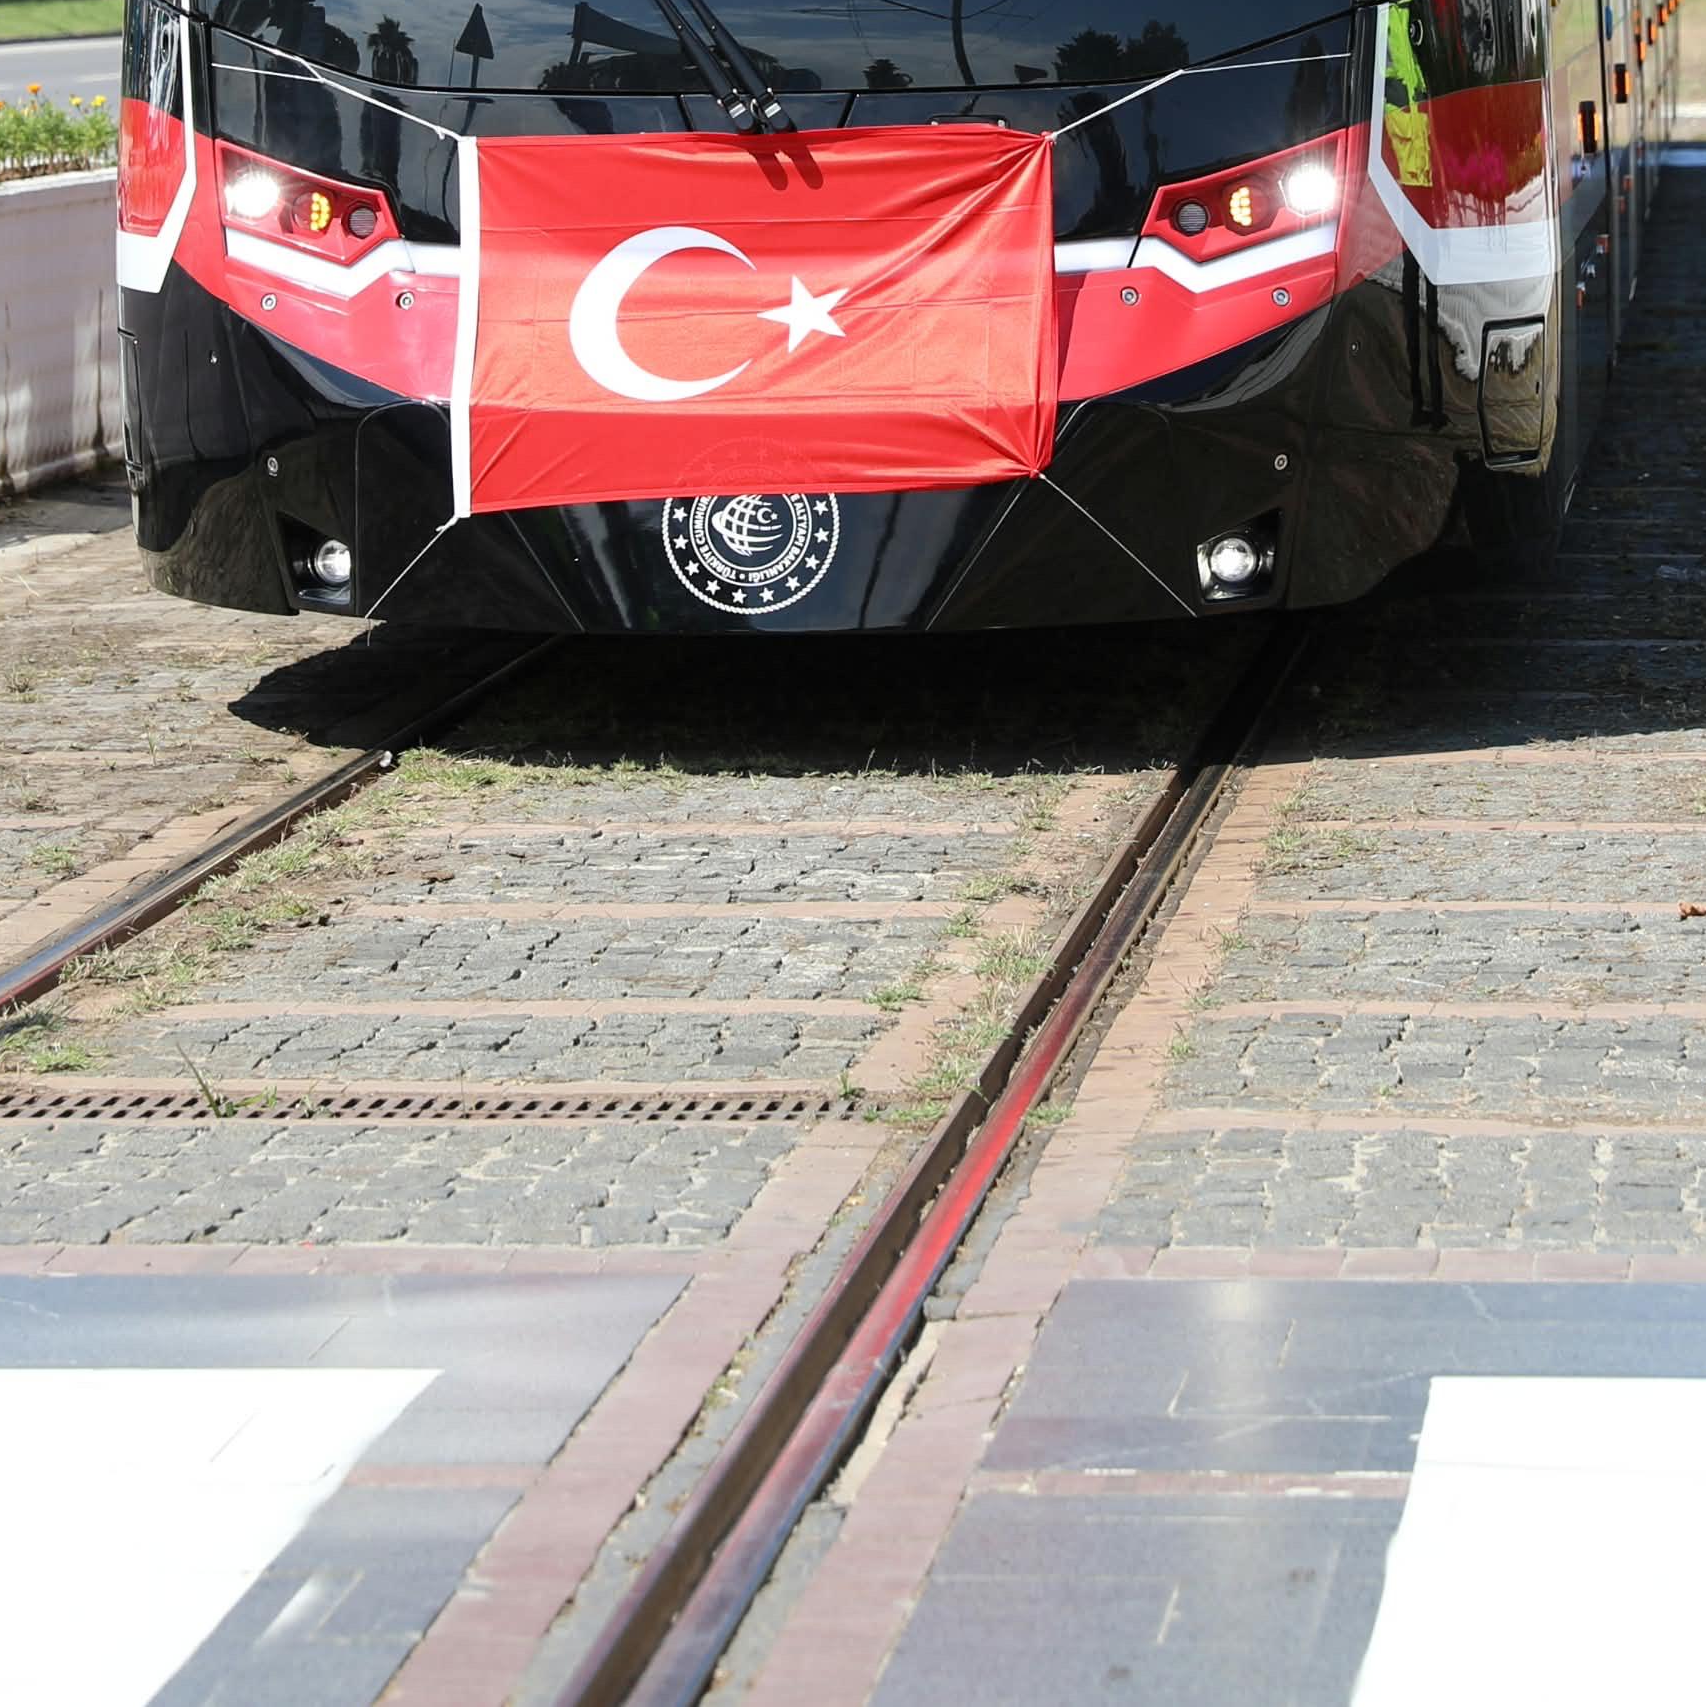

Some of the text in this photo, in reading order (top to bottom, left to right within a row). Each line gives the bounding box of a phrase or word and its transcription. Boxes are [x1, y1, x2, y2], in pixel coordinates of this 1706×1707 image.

[694, 495, 712, 544] CUMHUR
[794, 501, 810, 548] ALTYAPI
[699, 542, 737, 580] TÜRKİYE
[748, 546, 801, 583] BAKANLIĞI
